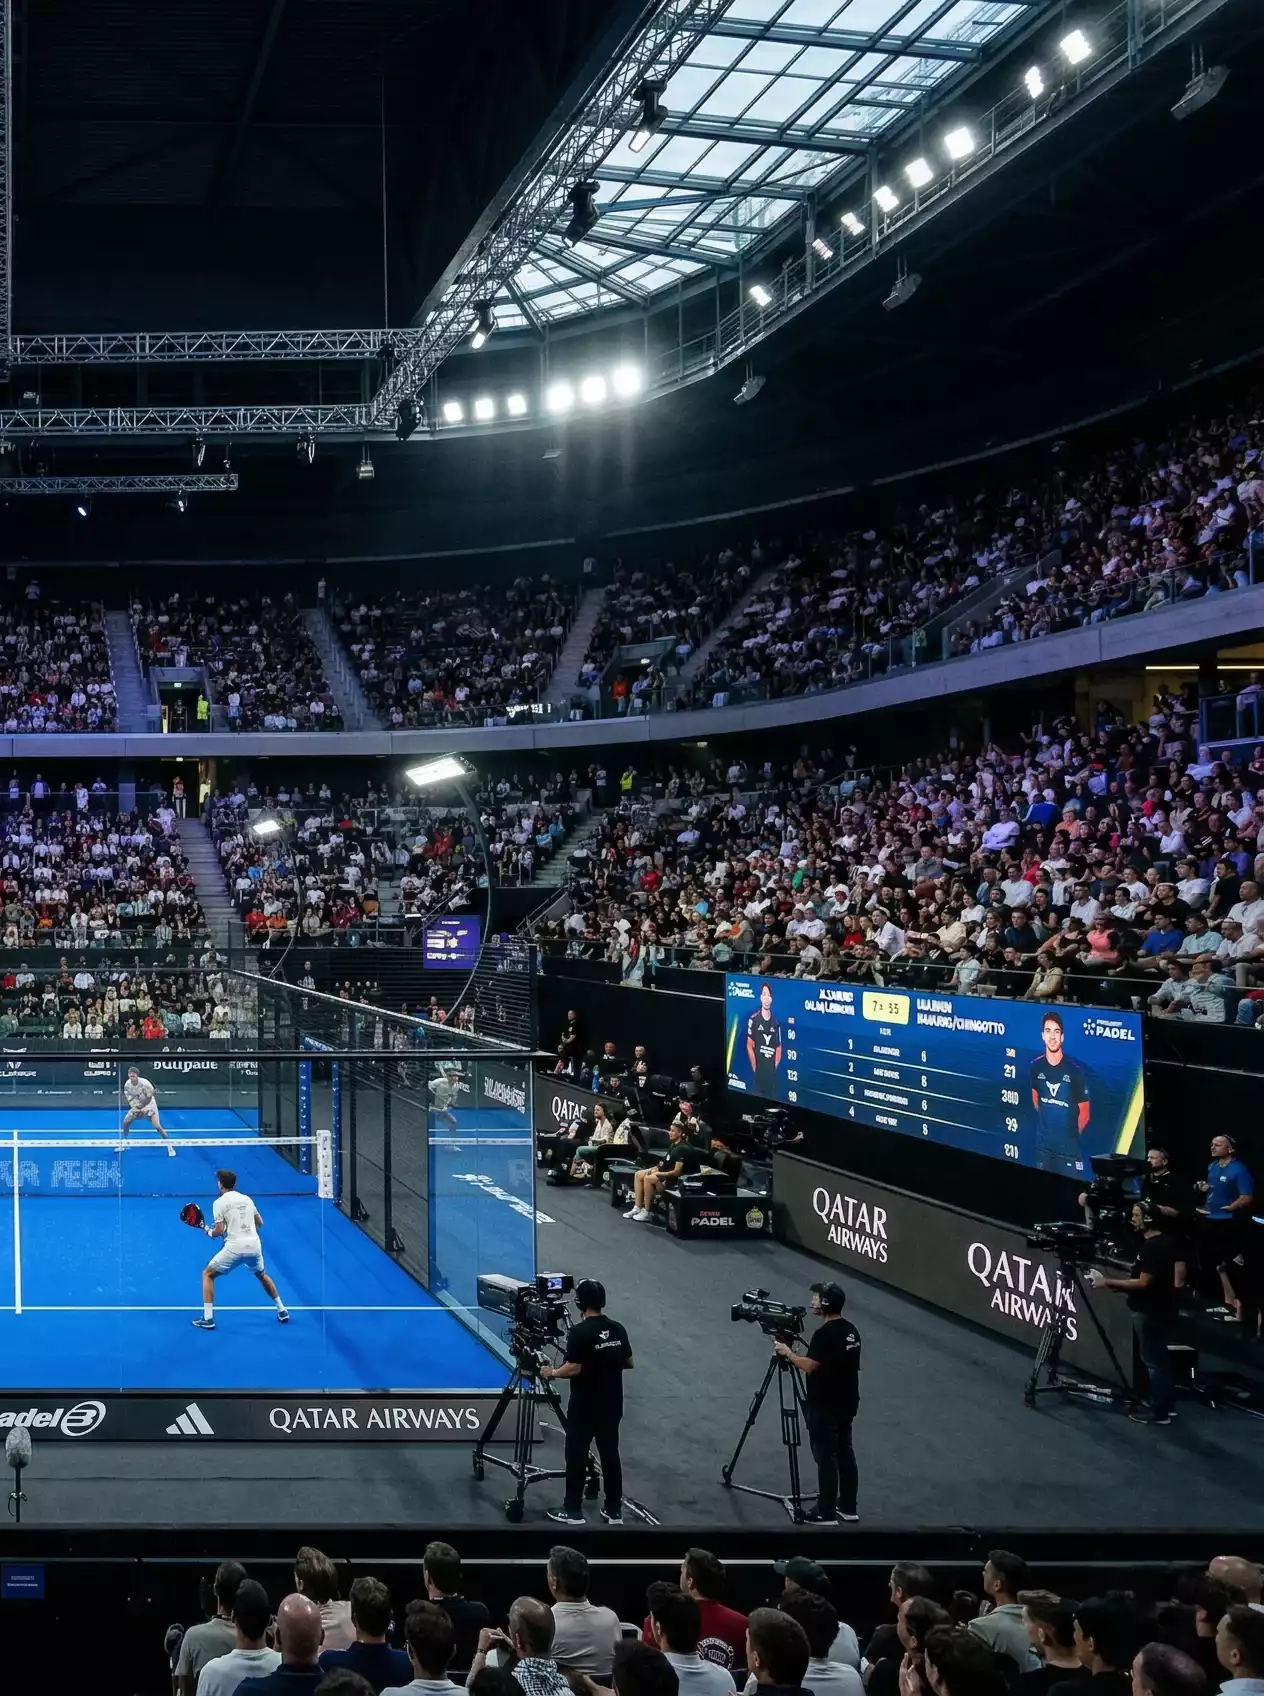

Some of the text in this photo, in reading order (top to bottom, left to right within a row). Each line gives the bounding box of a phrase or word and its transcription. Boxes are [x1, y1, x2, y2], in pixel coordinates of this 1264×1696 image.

[1095, 1026, 1135, 1041] PADEL
[690, 1216, 736, 1227] PADEL
[812, 1187, 888, 1240] QATAR
[828, 1225, 888, 1263] AIRWAYS
[269, 1407, 480, 1434] QATAR AIRWAYS
